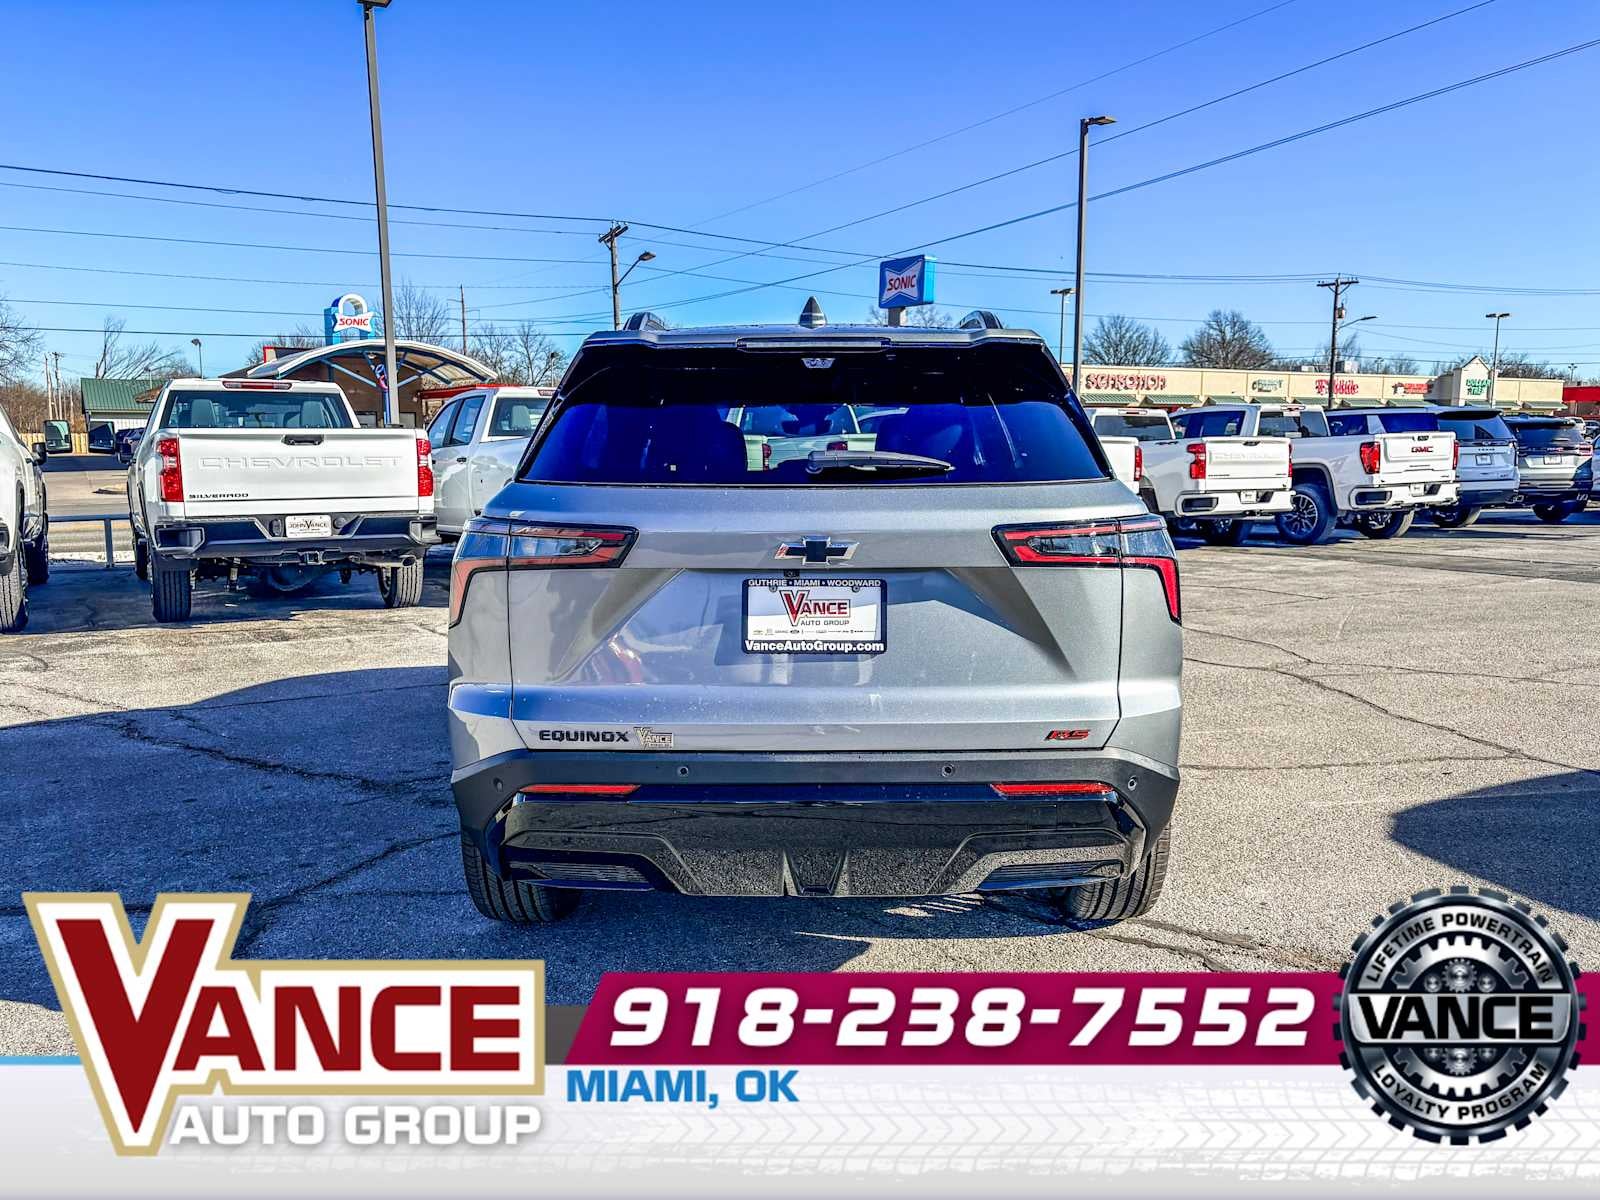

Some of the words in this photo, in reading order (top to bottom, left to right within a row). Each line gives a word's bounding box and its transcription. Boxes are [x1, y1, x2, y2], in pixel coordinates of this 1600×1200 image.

[886, 274, 917, 291] SONIC
[338, 318, 369, 326] SONIC
[1411, 445, 1434, 453] GMC
[199, 455, 405, 471] CHEVROLET
[188, 492, 249, 500] SILVERADO
[748, 579, 788, 588] GUTHRIE
[793, 579, 821, 588] MIAMI
[827, 579, 881, 588] WOODWARD
[781, 591, 849, 621] VANCE
[800, 619, 821, 627] AUTO
[823, 619, 850, 627] GROUP
[745, 640, 885, 653] VanceAutoGroup.com
[538, 729, 629, 743] EQUINOX
[1044, 729, 1090, 741] RS
